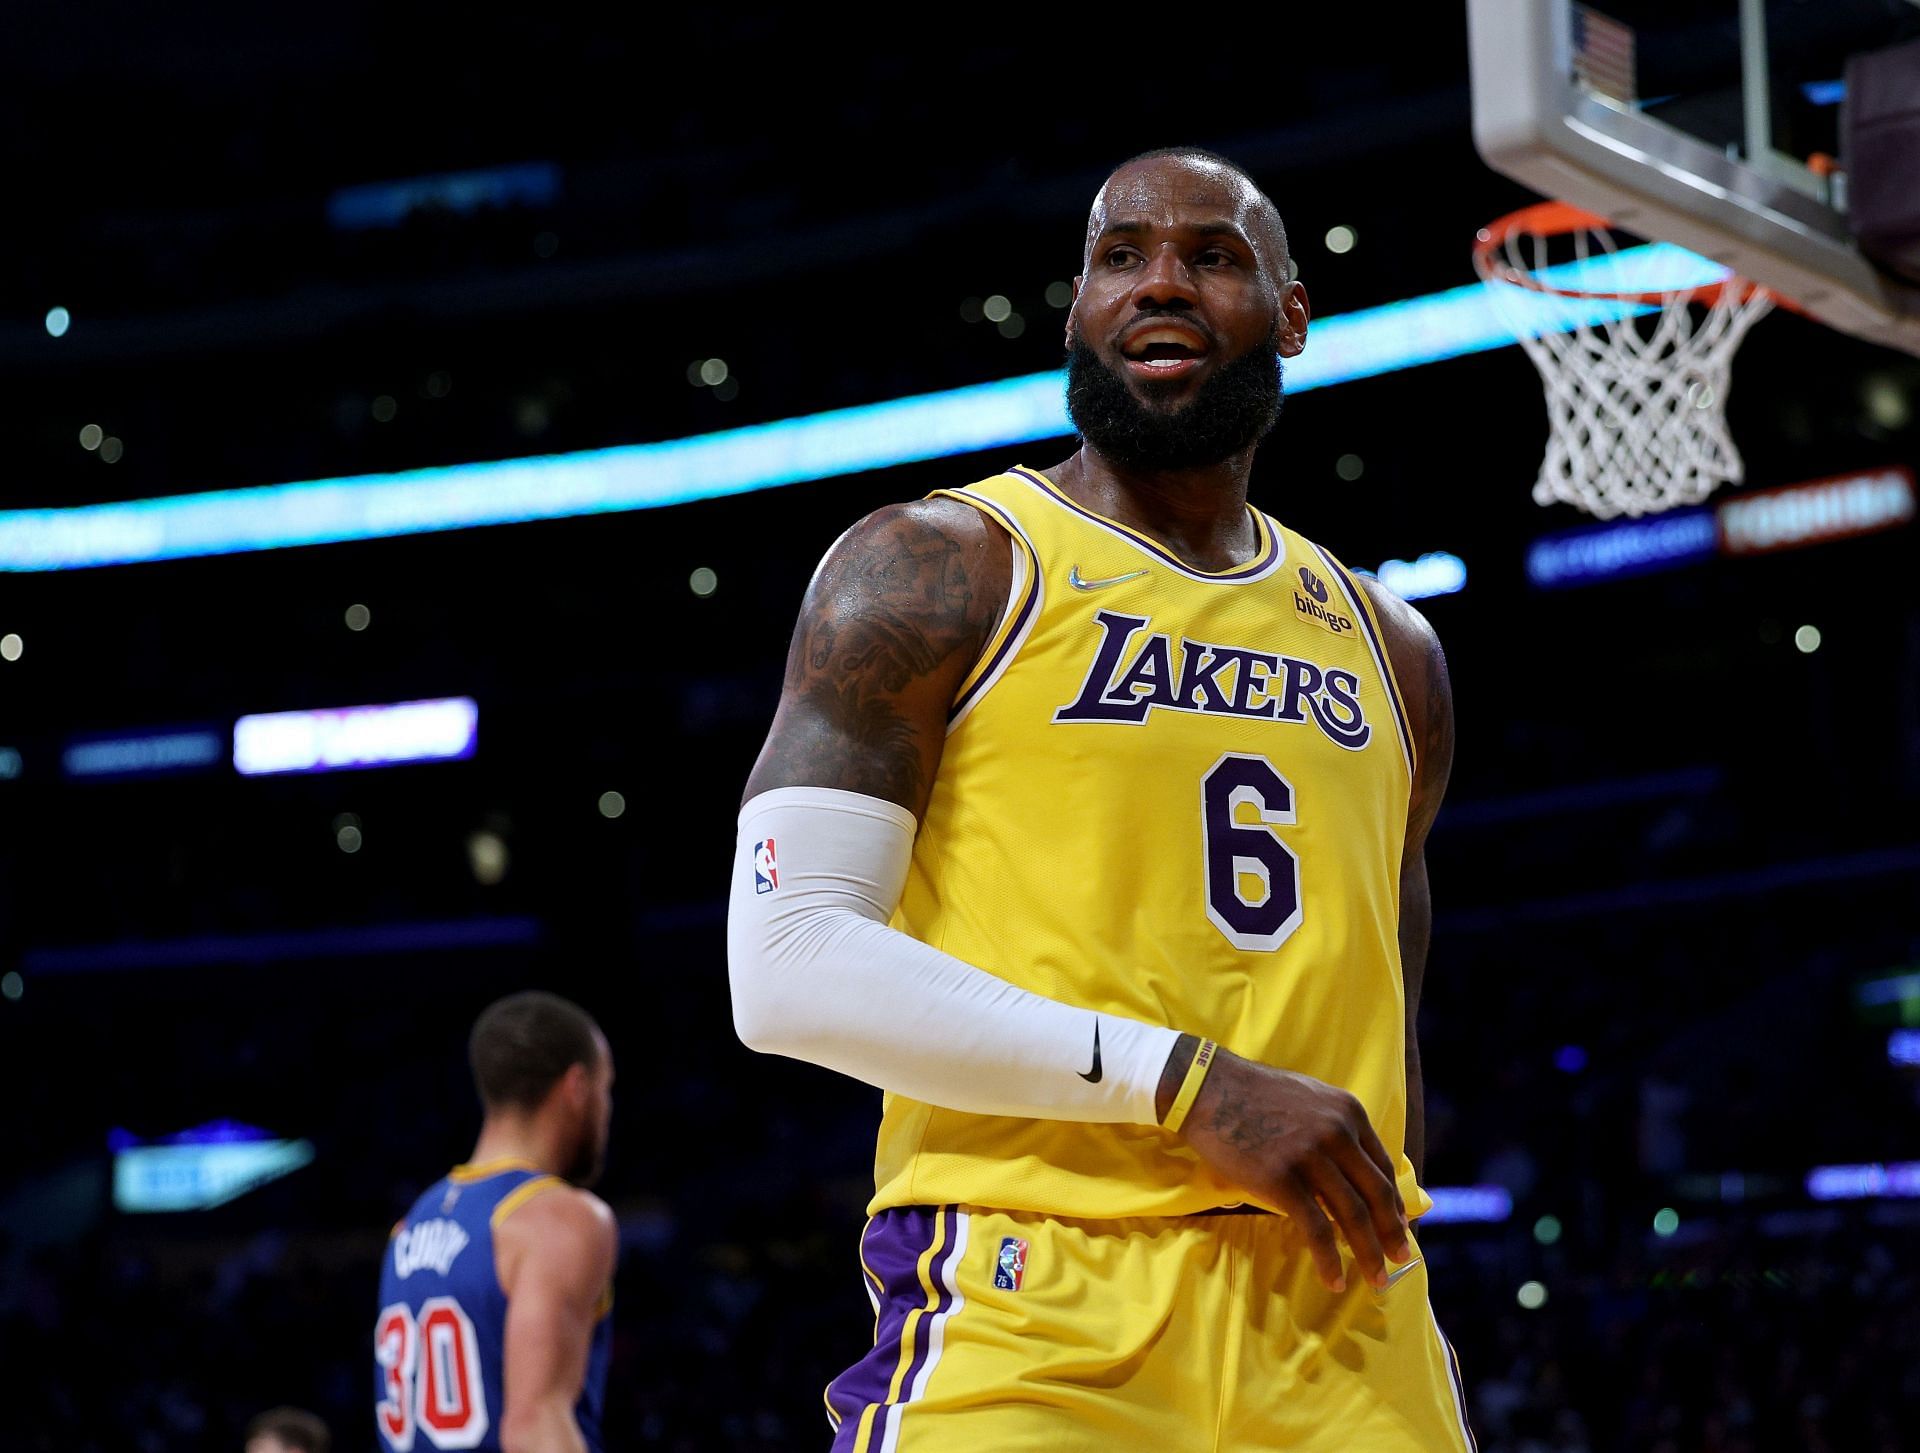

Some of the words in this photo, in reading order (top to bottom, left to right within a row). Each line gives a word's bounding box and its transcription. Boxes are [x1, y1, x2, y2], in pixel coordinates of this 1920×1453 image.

[1051, 608, 1373, 752] LAKERS
[1293, 591, 1352, 633] bibigo
[1200, 751, 1304, 953] 6
[374, 1296, 490, 1452] 30
